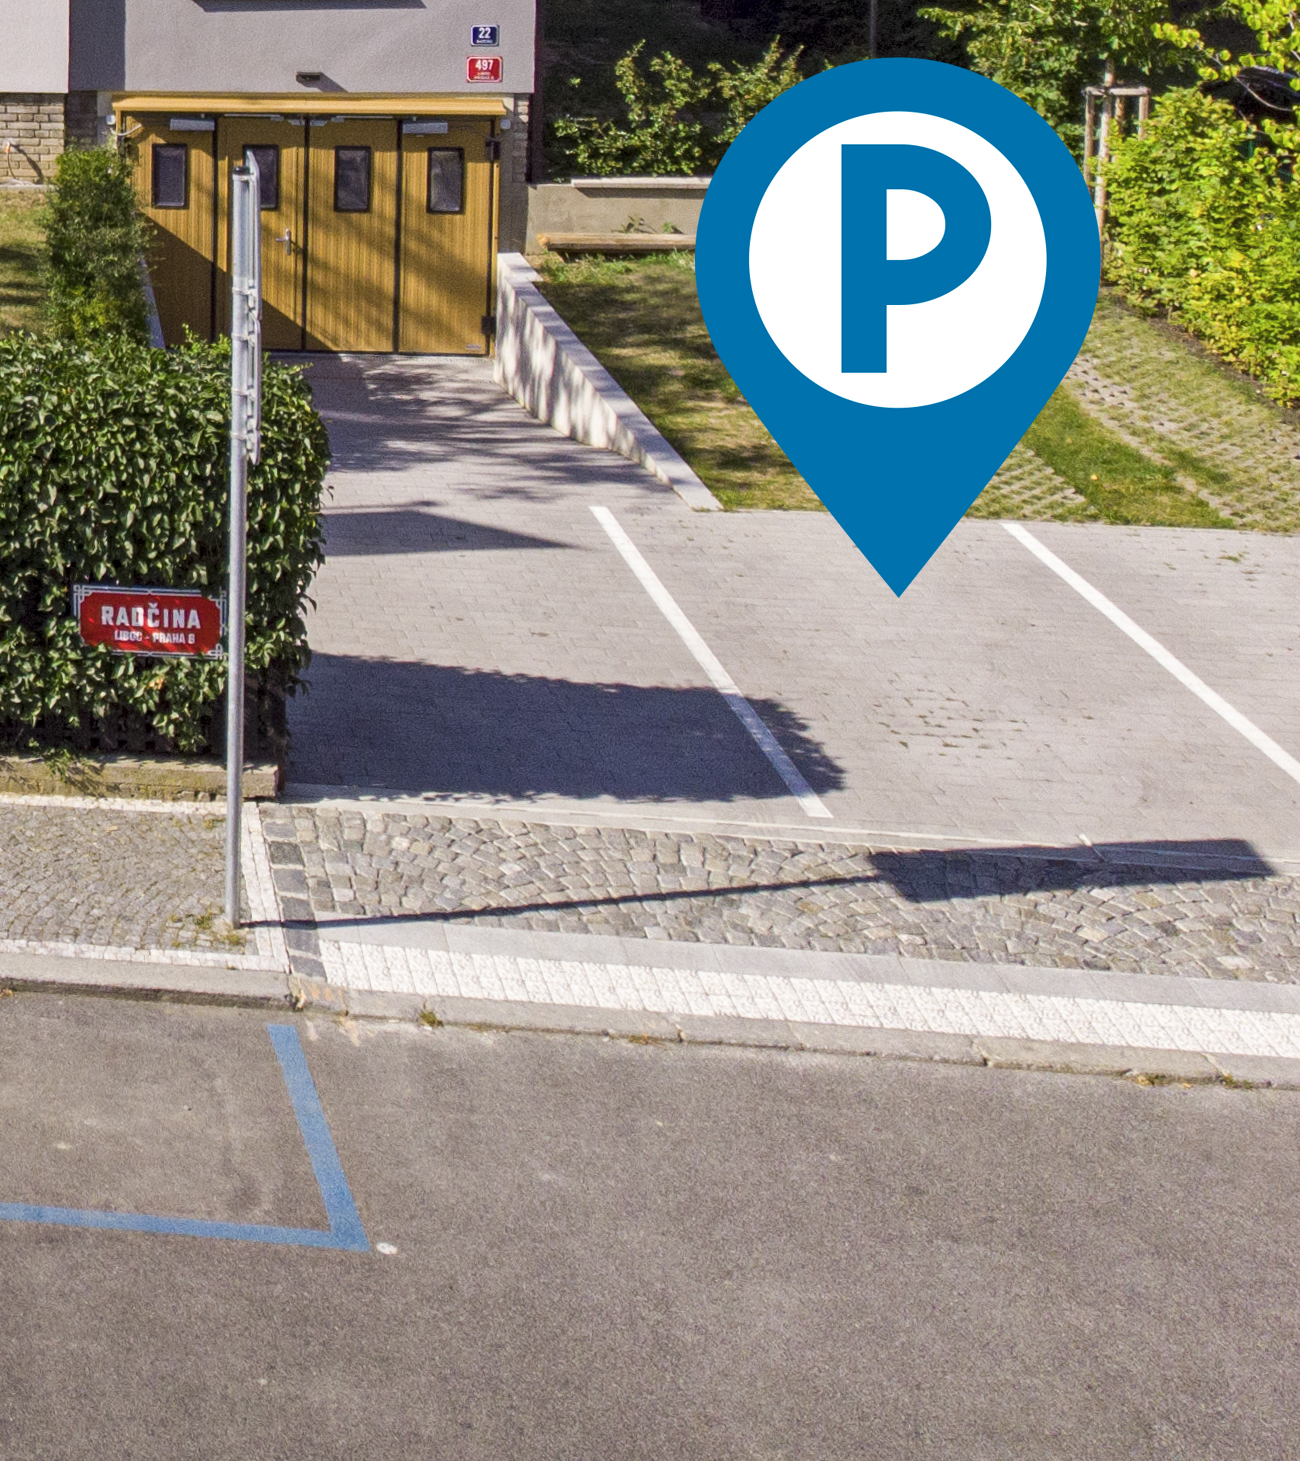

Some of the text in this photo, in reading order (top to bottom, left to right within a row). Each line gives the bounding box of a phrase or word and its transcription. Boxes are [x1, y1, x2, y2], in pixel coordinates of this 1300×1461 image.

[478, 27, 492, 39] 22
[475, 59, 494, 71] 497
[101, 602, 201, 629] RADČINA
[152, 632, 186, 645] PRAHA
